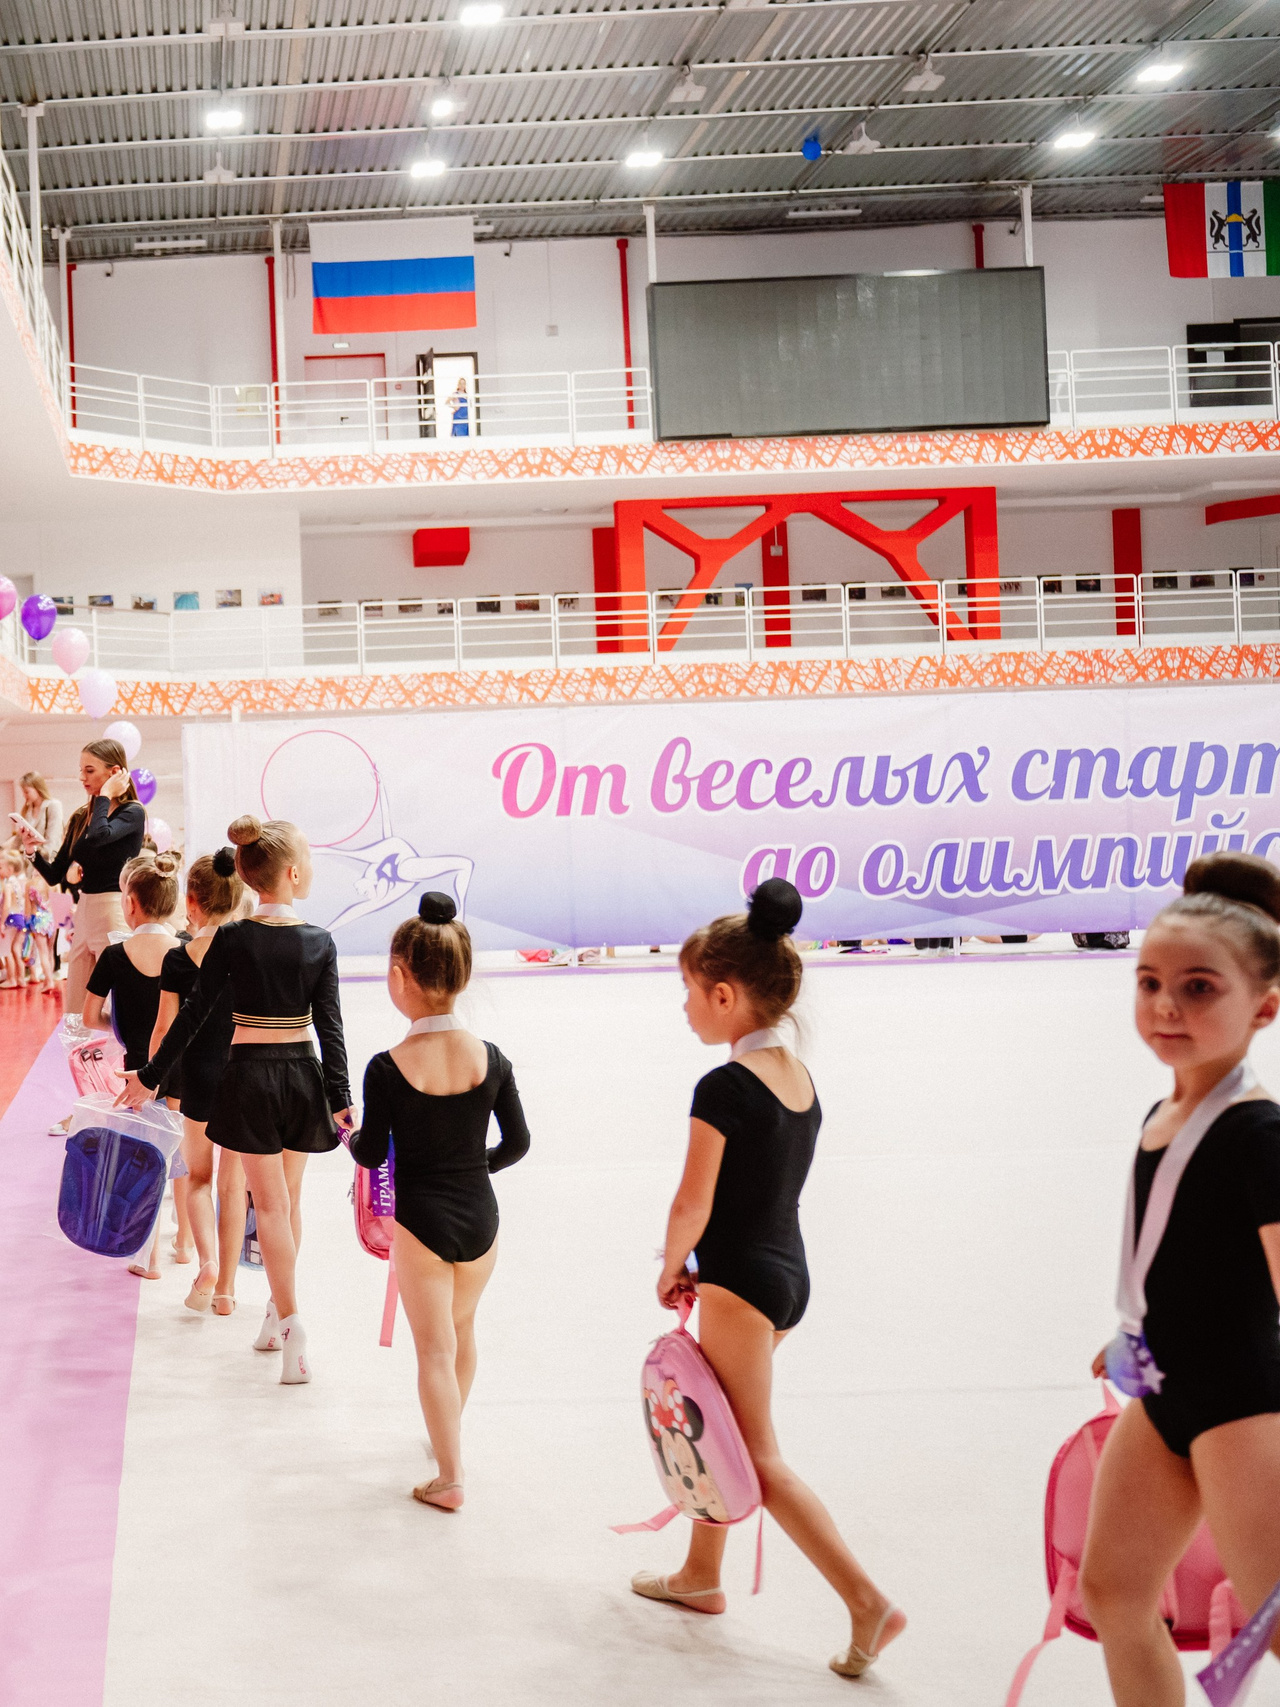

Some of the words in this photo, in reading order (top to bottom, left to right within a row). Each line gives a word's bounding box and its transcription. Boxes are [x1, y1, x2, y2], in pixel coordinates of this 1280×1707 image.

[492, 741, 630, 819] От
[650, 736, 991, 814] веселых
[1011, 740, 1280, 823] старт
[742, 844, 837, 899] до
